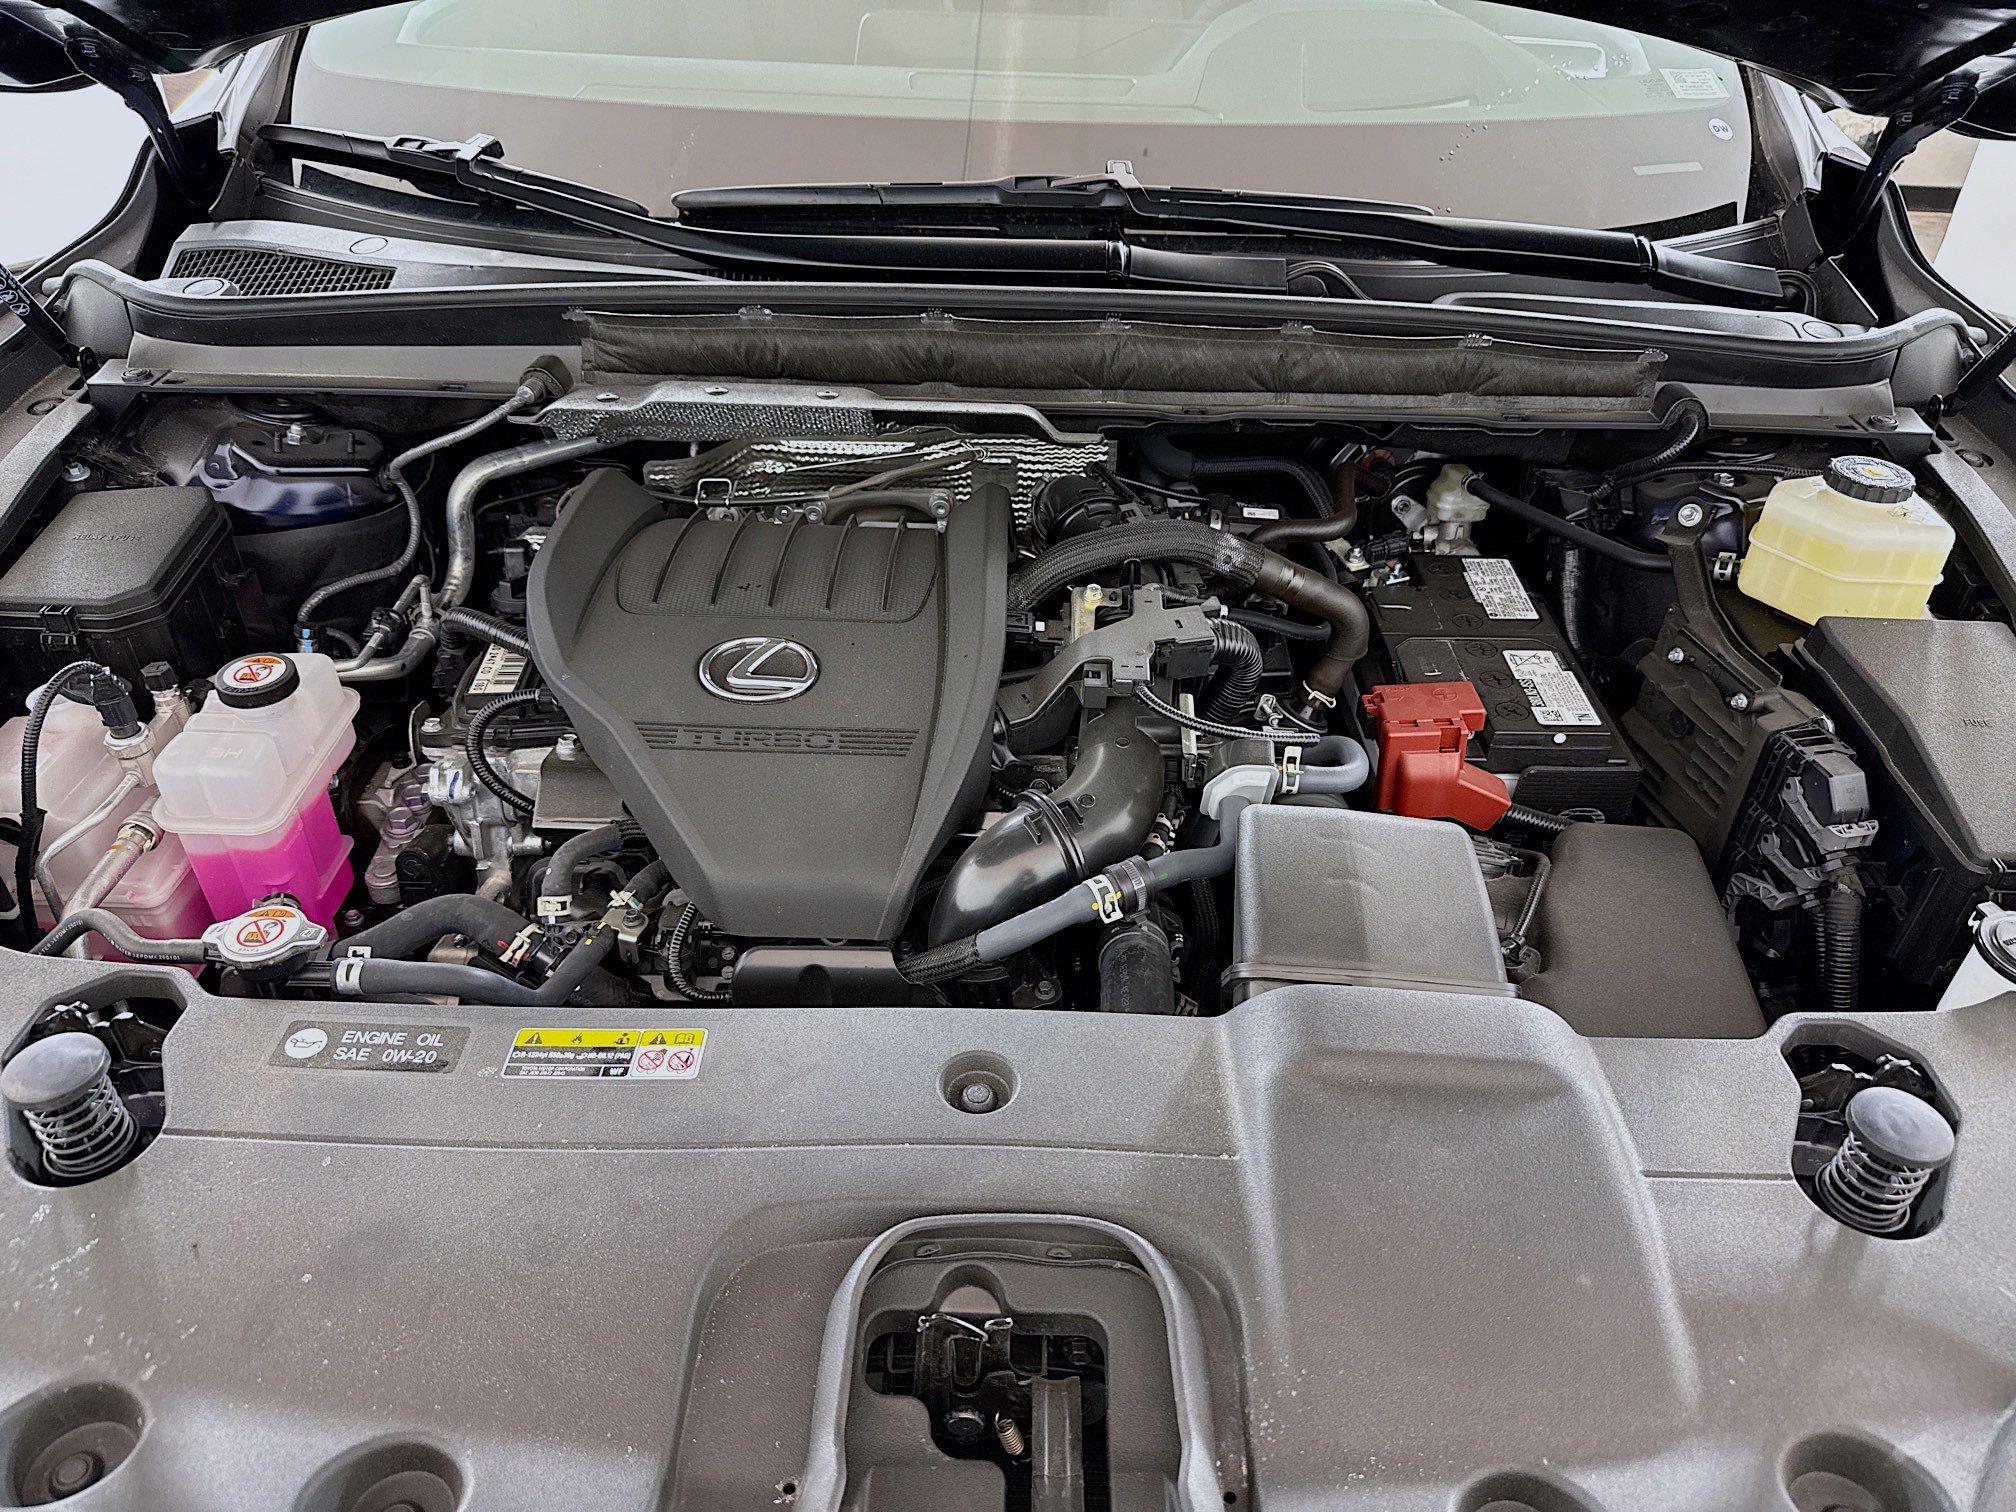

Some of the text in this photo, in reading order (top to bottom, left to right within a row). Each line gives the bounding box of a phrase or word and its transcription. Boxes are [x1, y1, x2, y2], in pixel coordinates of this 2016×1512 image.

[1712, 125, 1729, 133] DW
[1962, 718, 1993, 728] FUSE
[677, 727, 839, 750] TURBO
[341, 1030, 444, 1047] ENGINE OIL
[333, 1046, 438, 1064] SAE 0W-20
